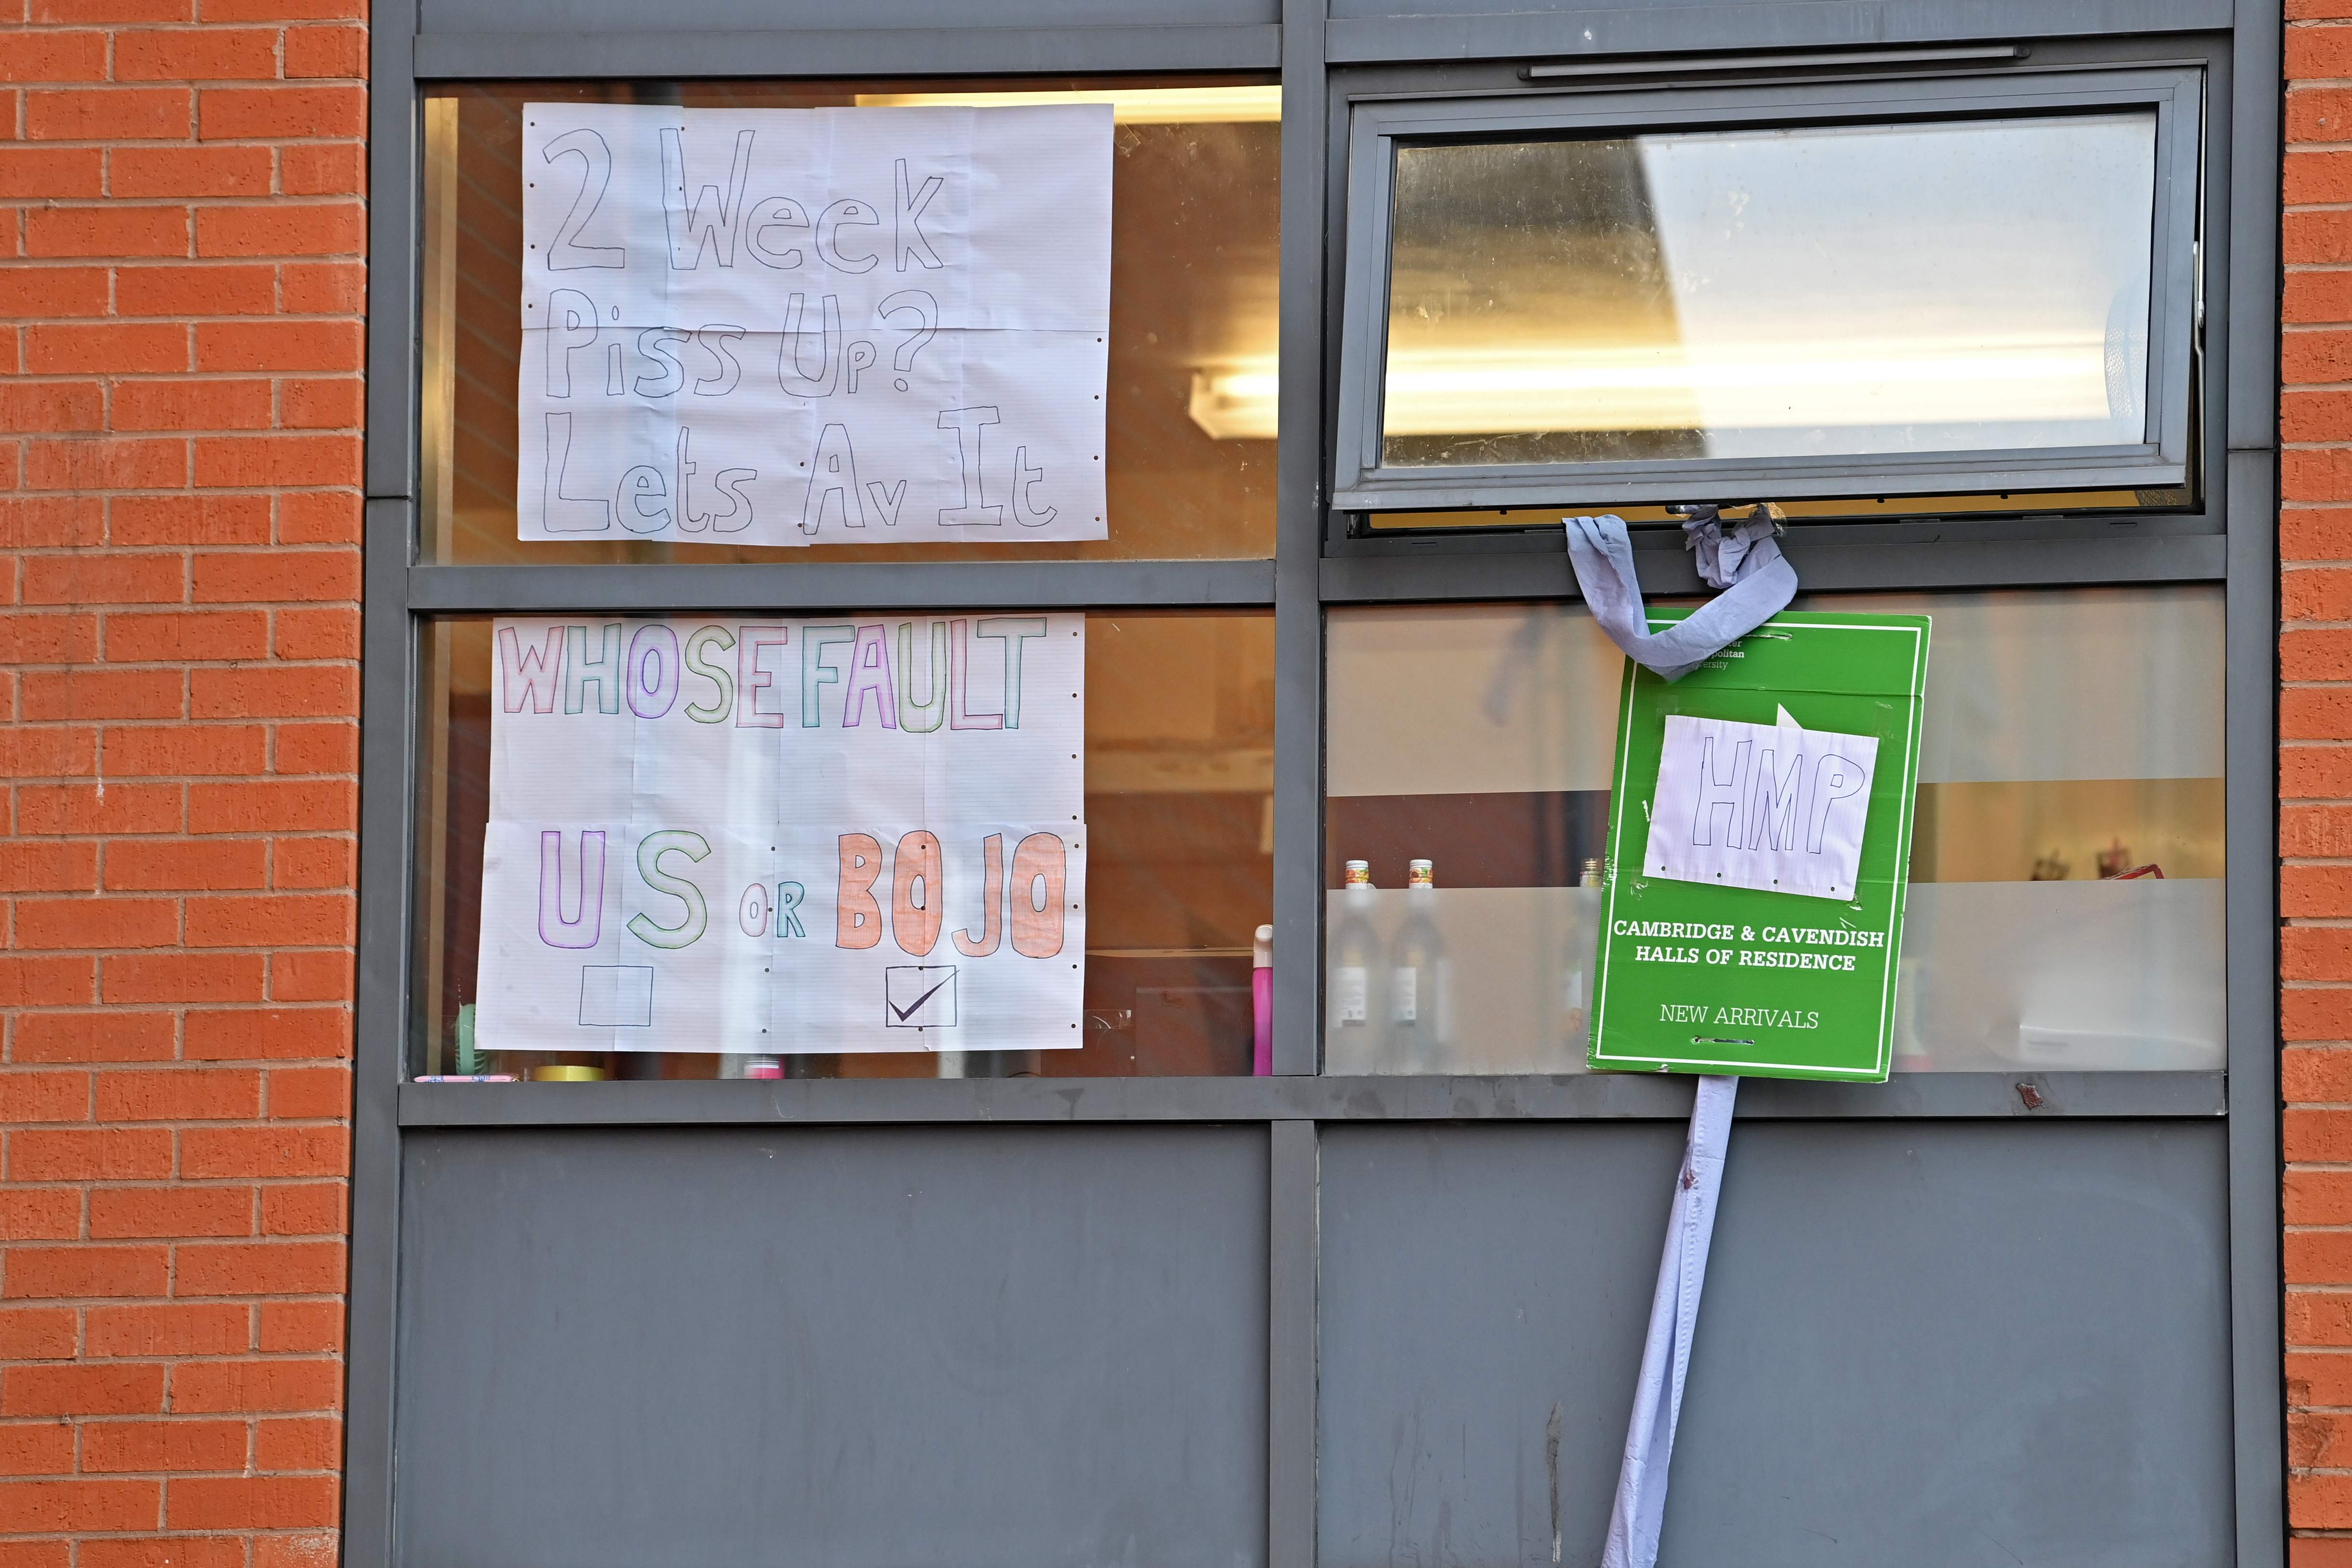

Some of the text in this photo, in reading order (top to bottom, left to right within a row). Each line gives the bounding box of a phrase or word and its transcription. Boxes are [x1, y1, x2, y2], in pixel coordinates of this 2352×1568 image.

[542, 127, 944, 274] 2 Week
[545, 288, 939, 399] Piss Up?
[543, 405, 1058, 536] Lets Av It
[497, 617, 1048, 733] WHOSE FAULT
[1711, 649, 1745, 659] politan
[1692, 736, 1866, 855] HMP
[538, 828, 1067, 959] US OR BOJO
[1614, 920, 1885, 948] CAMBRIDGE & CAVENDISH
[1634, 945, 1856, 971] HALLS OF RESIDENCE
[1659, 1004, 1819, 1029] NEW ARRIVALS
